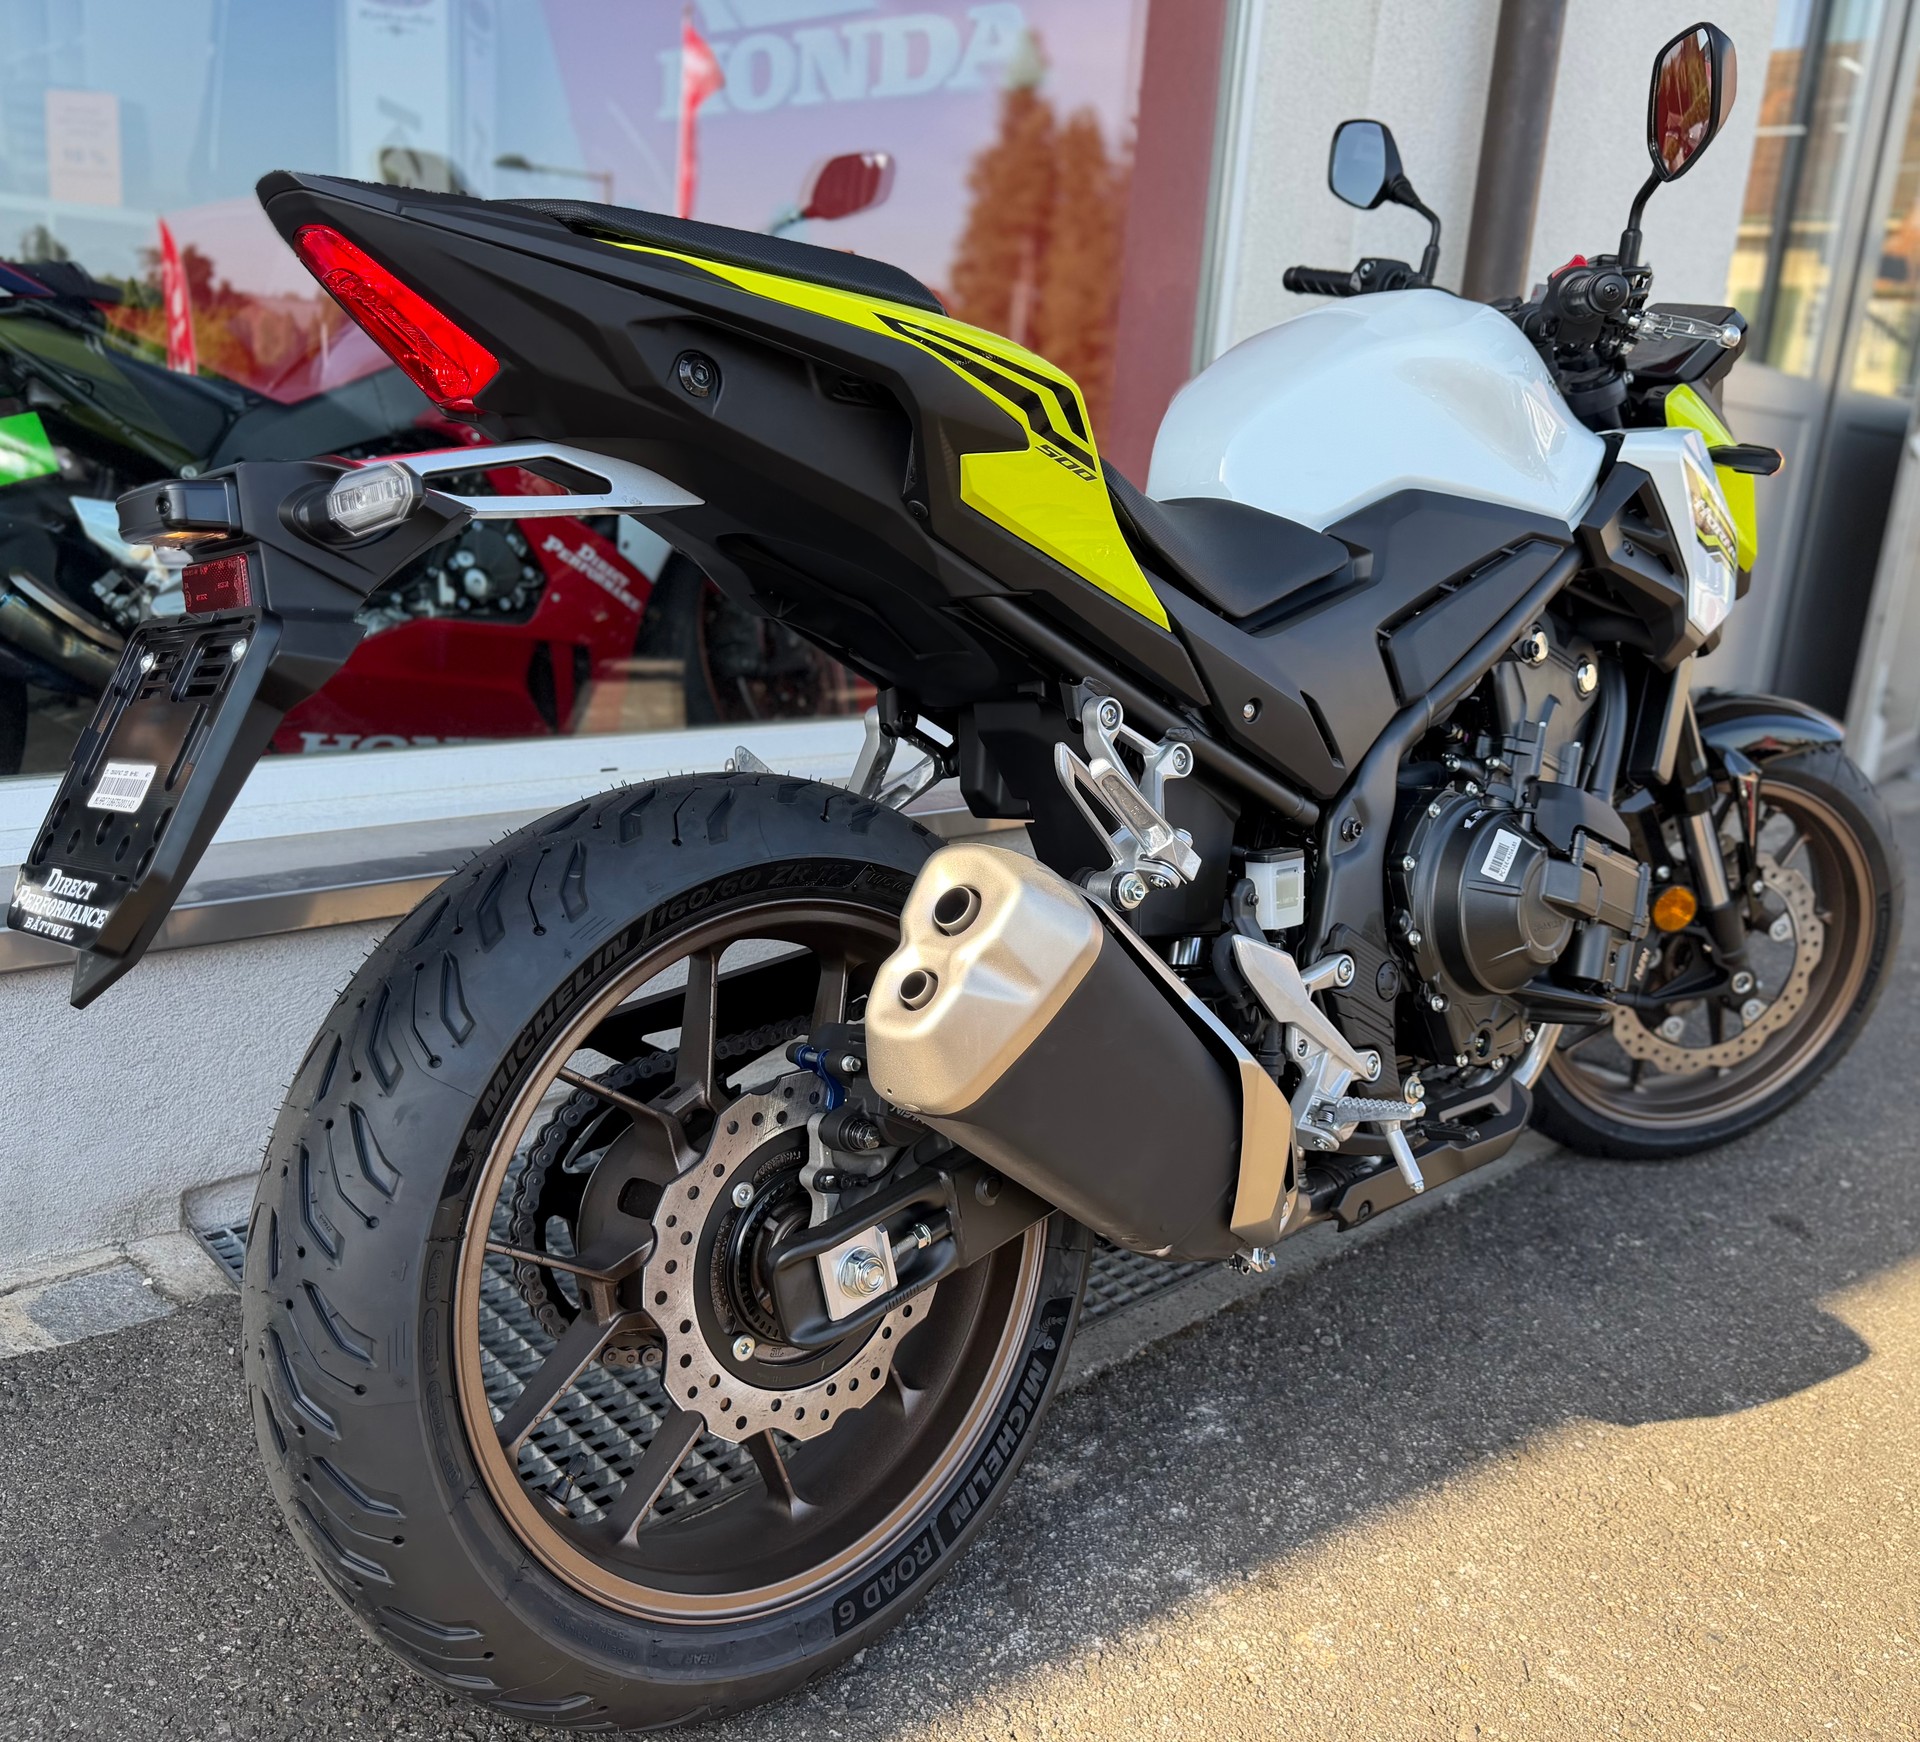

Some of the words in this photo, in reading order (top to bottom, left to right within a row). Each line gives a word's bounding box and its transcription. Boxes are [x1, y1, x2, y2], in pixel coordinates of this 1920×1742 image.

[655, 2, 1033, 121] HONDA
[1035, 444, 1098, 481] 500
[42, 868, 98, 900] DIRECT
[656, 868, 761, 926] 160/60
[11, 885, 110, 929] PERFORMANCE
[23, 916, 74, 941] BÄTTWIL
[481, 931, 630, 1117] MICHELIN
[949, 1357, 1047, 1529] MICHELIN
[863, 1537, 936, 1602] ROAD
[838, 1606, 856, 1628] 6
[684, 1652, 719, 1665] REAR
